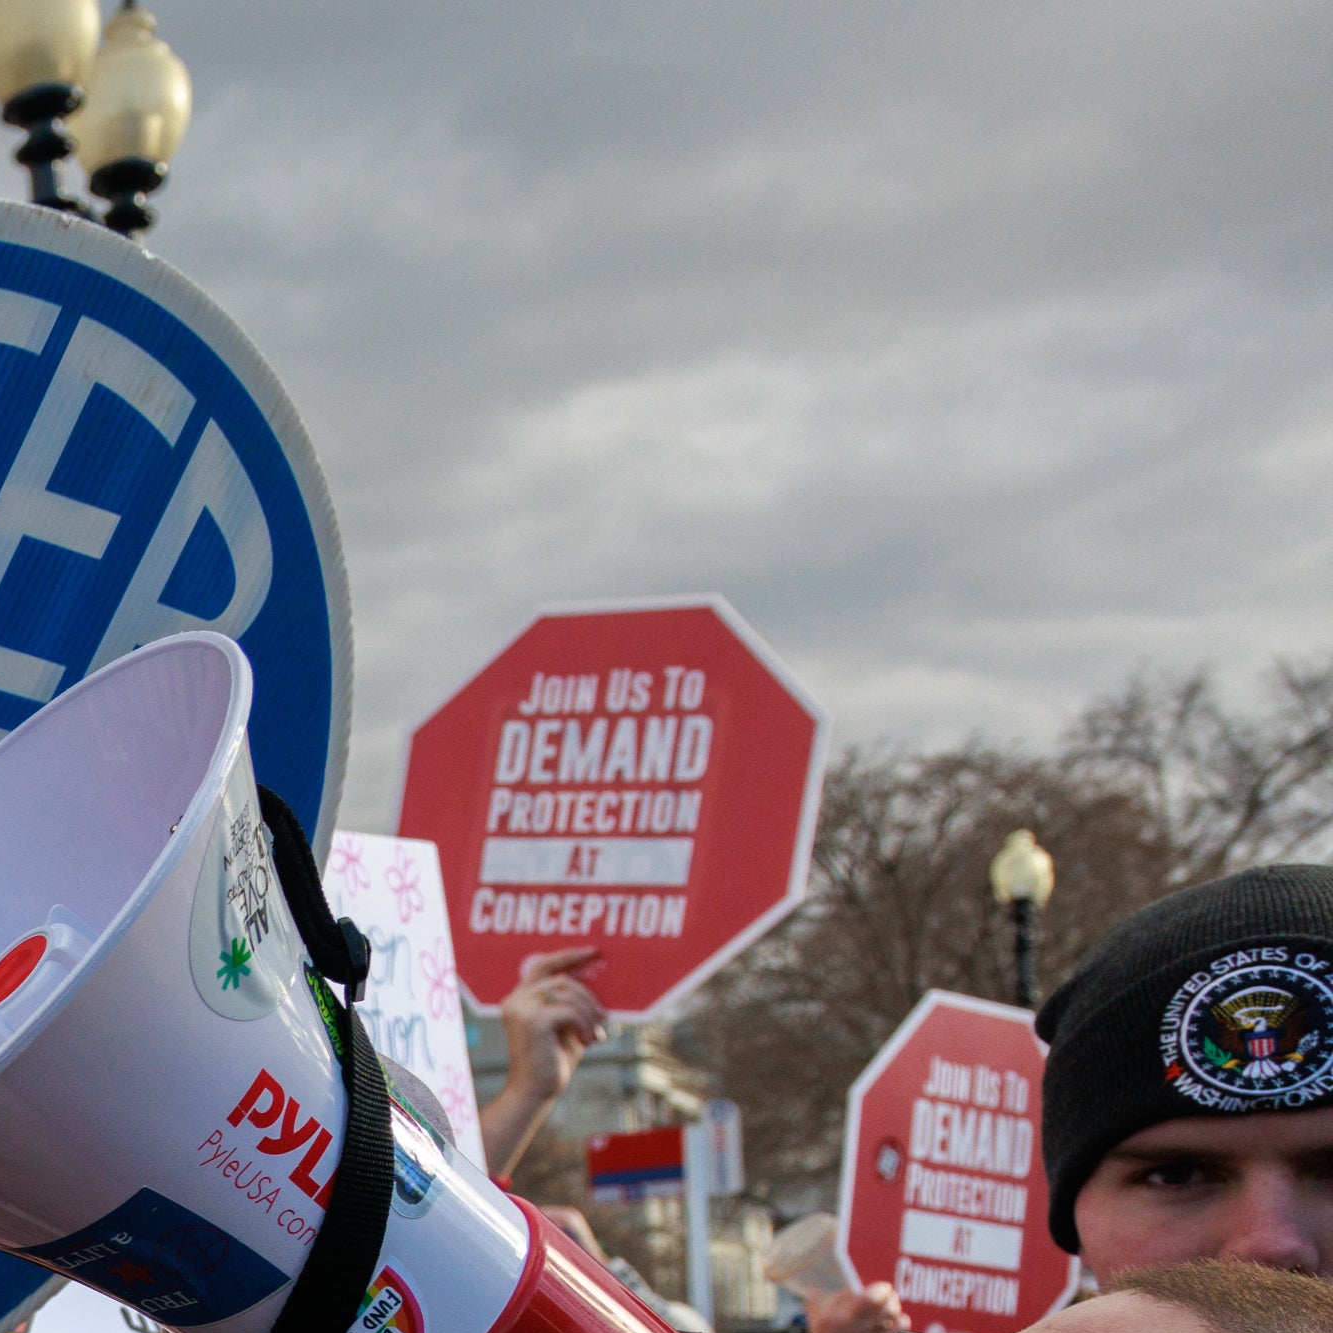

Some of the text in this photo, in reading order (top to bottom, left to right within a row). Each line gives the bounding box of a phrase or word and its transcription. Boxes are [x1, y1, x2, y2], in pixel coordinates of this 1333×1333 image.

[493, 714, 713, 786] DEMAND
[486, 788, 702, 834] PROTECTION
[469, 887, 687, 938] CONCEPTION
[1159, 945, 1330, 1068] THE UNITED STATES OF
[908, 1097, 1033, 1180] DEMAND
[904, 1160, 1028, 1225] PROTECTION
[55, 1243, 120, 1270] LITT
[111, 1231, 133, 1246] a
[140, 1290, 201, 1314] TRU
[363, 1289, 402, 1330] FUND
[895, 1256, 1020, 1318] CONCEPTION
